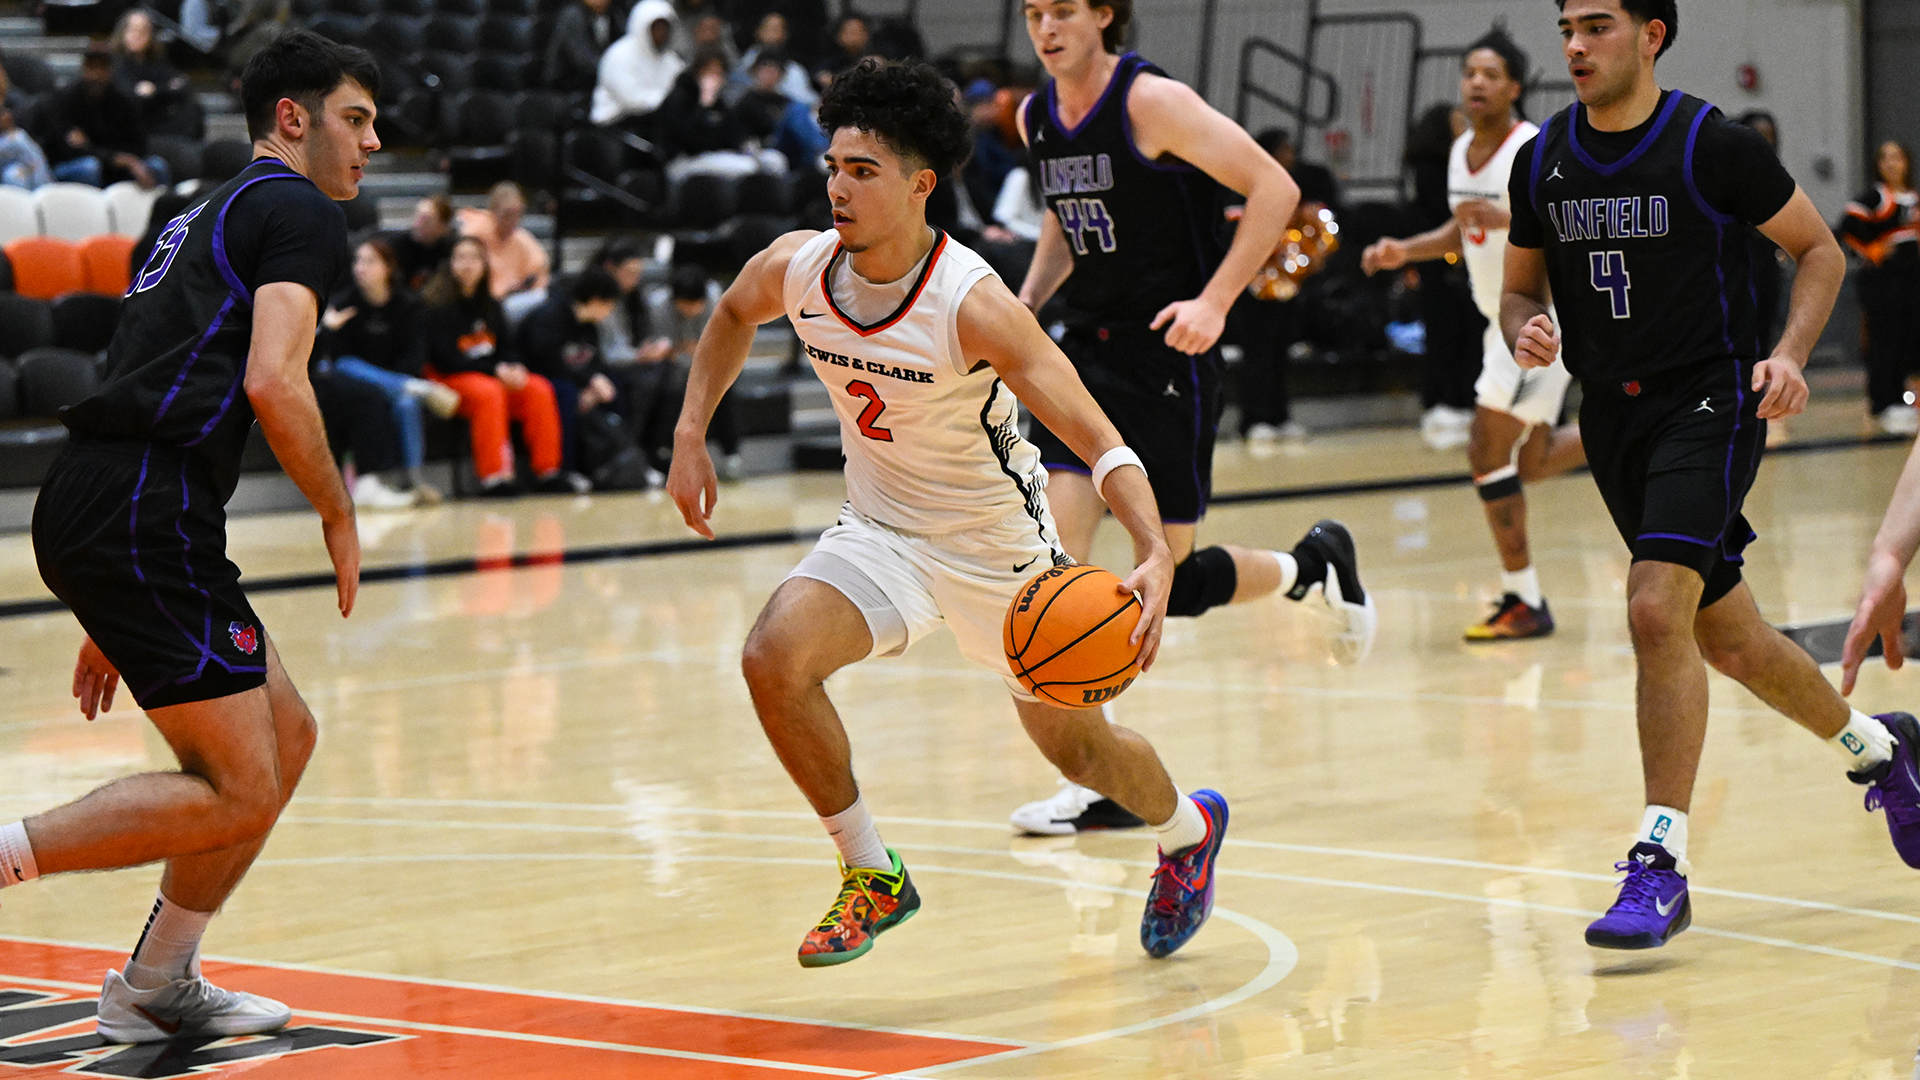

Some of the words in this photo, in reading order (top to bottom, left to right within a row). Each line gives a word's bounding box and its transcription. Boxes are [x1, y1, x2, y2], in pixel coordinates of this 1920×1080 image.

[1040, 153, 1114, 196] LINFIELD
[1056, 198, 1117, 255] 44
[1548, 195, 1669, 242] LINFIELD
[1589, 250, 1631, 319] 4
[852, 358, 865, 370] &
[866, 361, 935, 383] CLARK
[846, 379, 893, 442] 2
